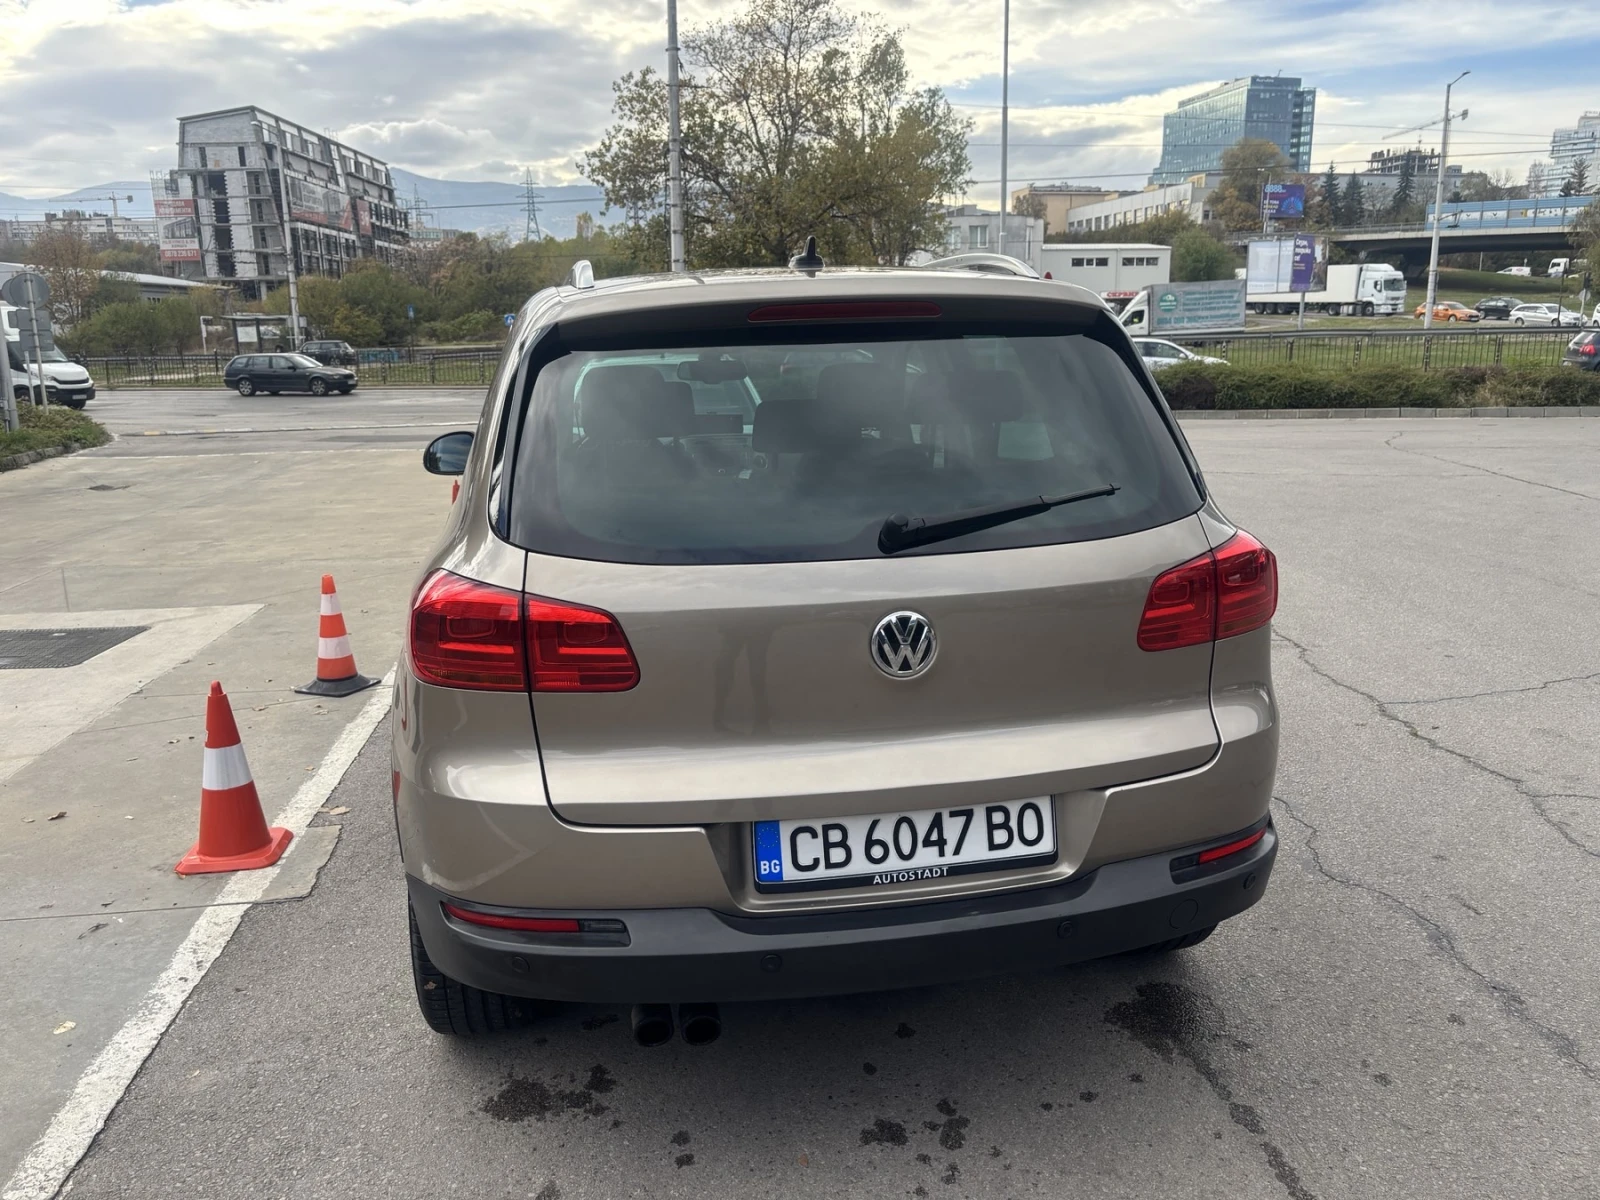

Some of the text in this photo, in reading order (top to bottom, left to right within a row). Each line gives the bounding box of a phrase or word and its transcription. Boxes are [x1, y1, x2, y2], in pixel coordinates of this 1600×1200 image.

[872, 611, 937, 679] VW
[789, 823, 852, 872] CB
[864, 808, 974, 865] 6047
[760, 860, 781, 875] BG
[872, 866, 949, 885] AUTOSTADT
